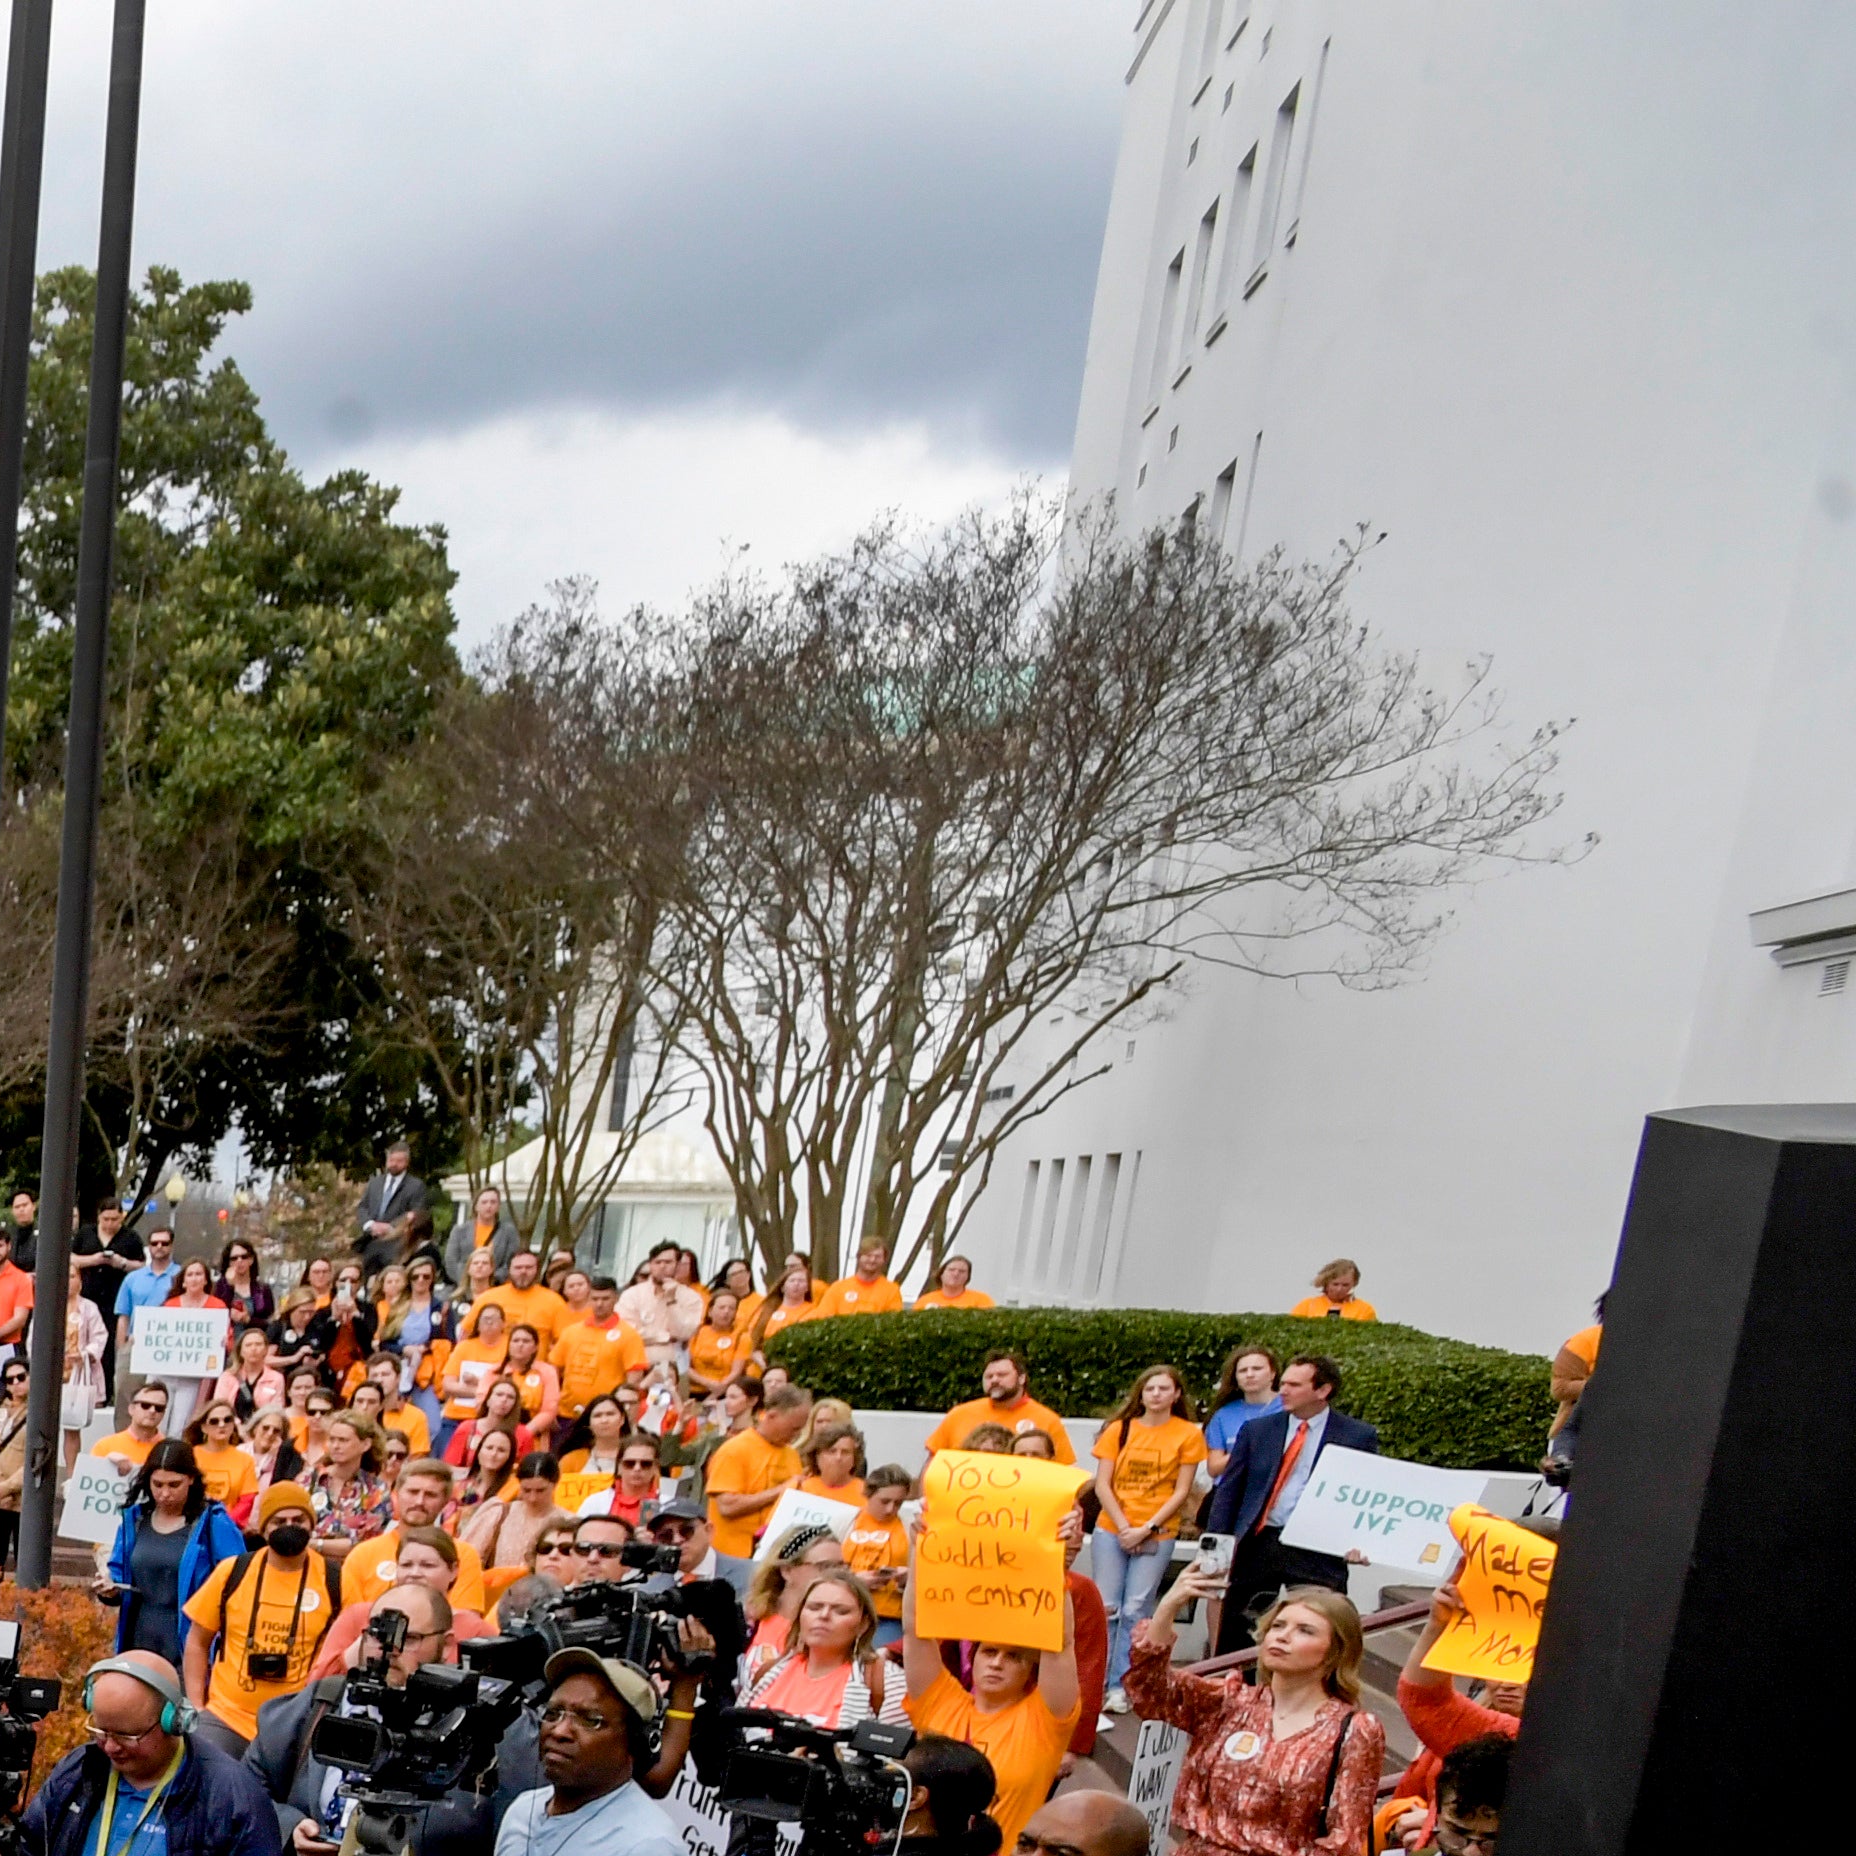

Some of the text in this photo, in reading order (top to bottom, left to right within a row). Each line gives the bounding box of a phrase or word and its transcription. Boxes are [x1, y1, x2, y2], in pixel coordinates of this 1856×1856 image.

[146, 1320, 213, 1333] I'M HERE
[144, 1334, 214, 1349] BECAUSE
[153, 1350, 202, 1363] OF IVF
[793, 1506, 832, 1523] FIG
[1316, 1480, 1326, 1498] I
[1334, 1484, 1454, 1525] SUPPORT
[1353, 1512, 1402, 1537] IVF
[1461, 1528, 1554, 1586] Made
[925, 1584, 1057, 1617] an embryo
[1452, 1609, 1477, 1635] A
[1140, 1724, 1152, 1759] I
[1136, 1761, 1172, 1803] WANT
